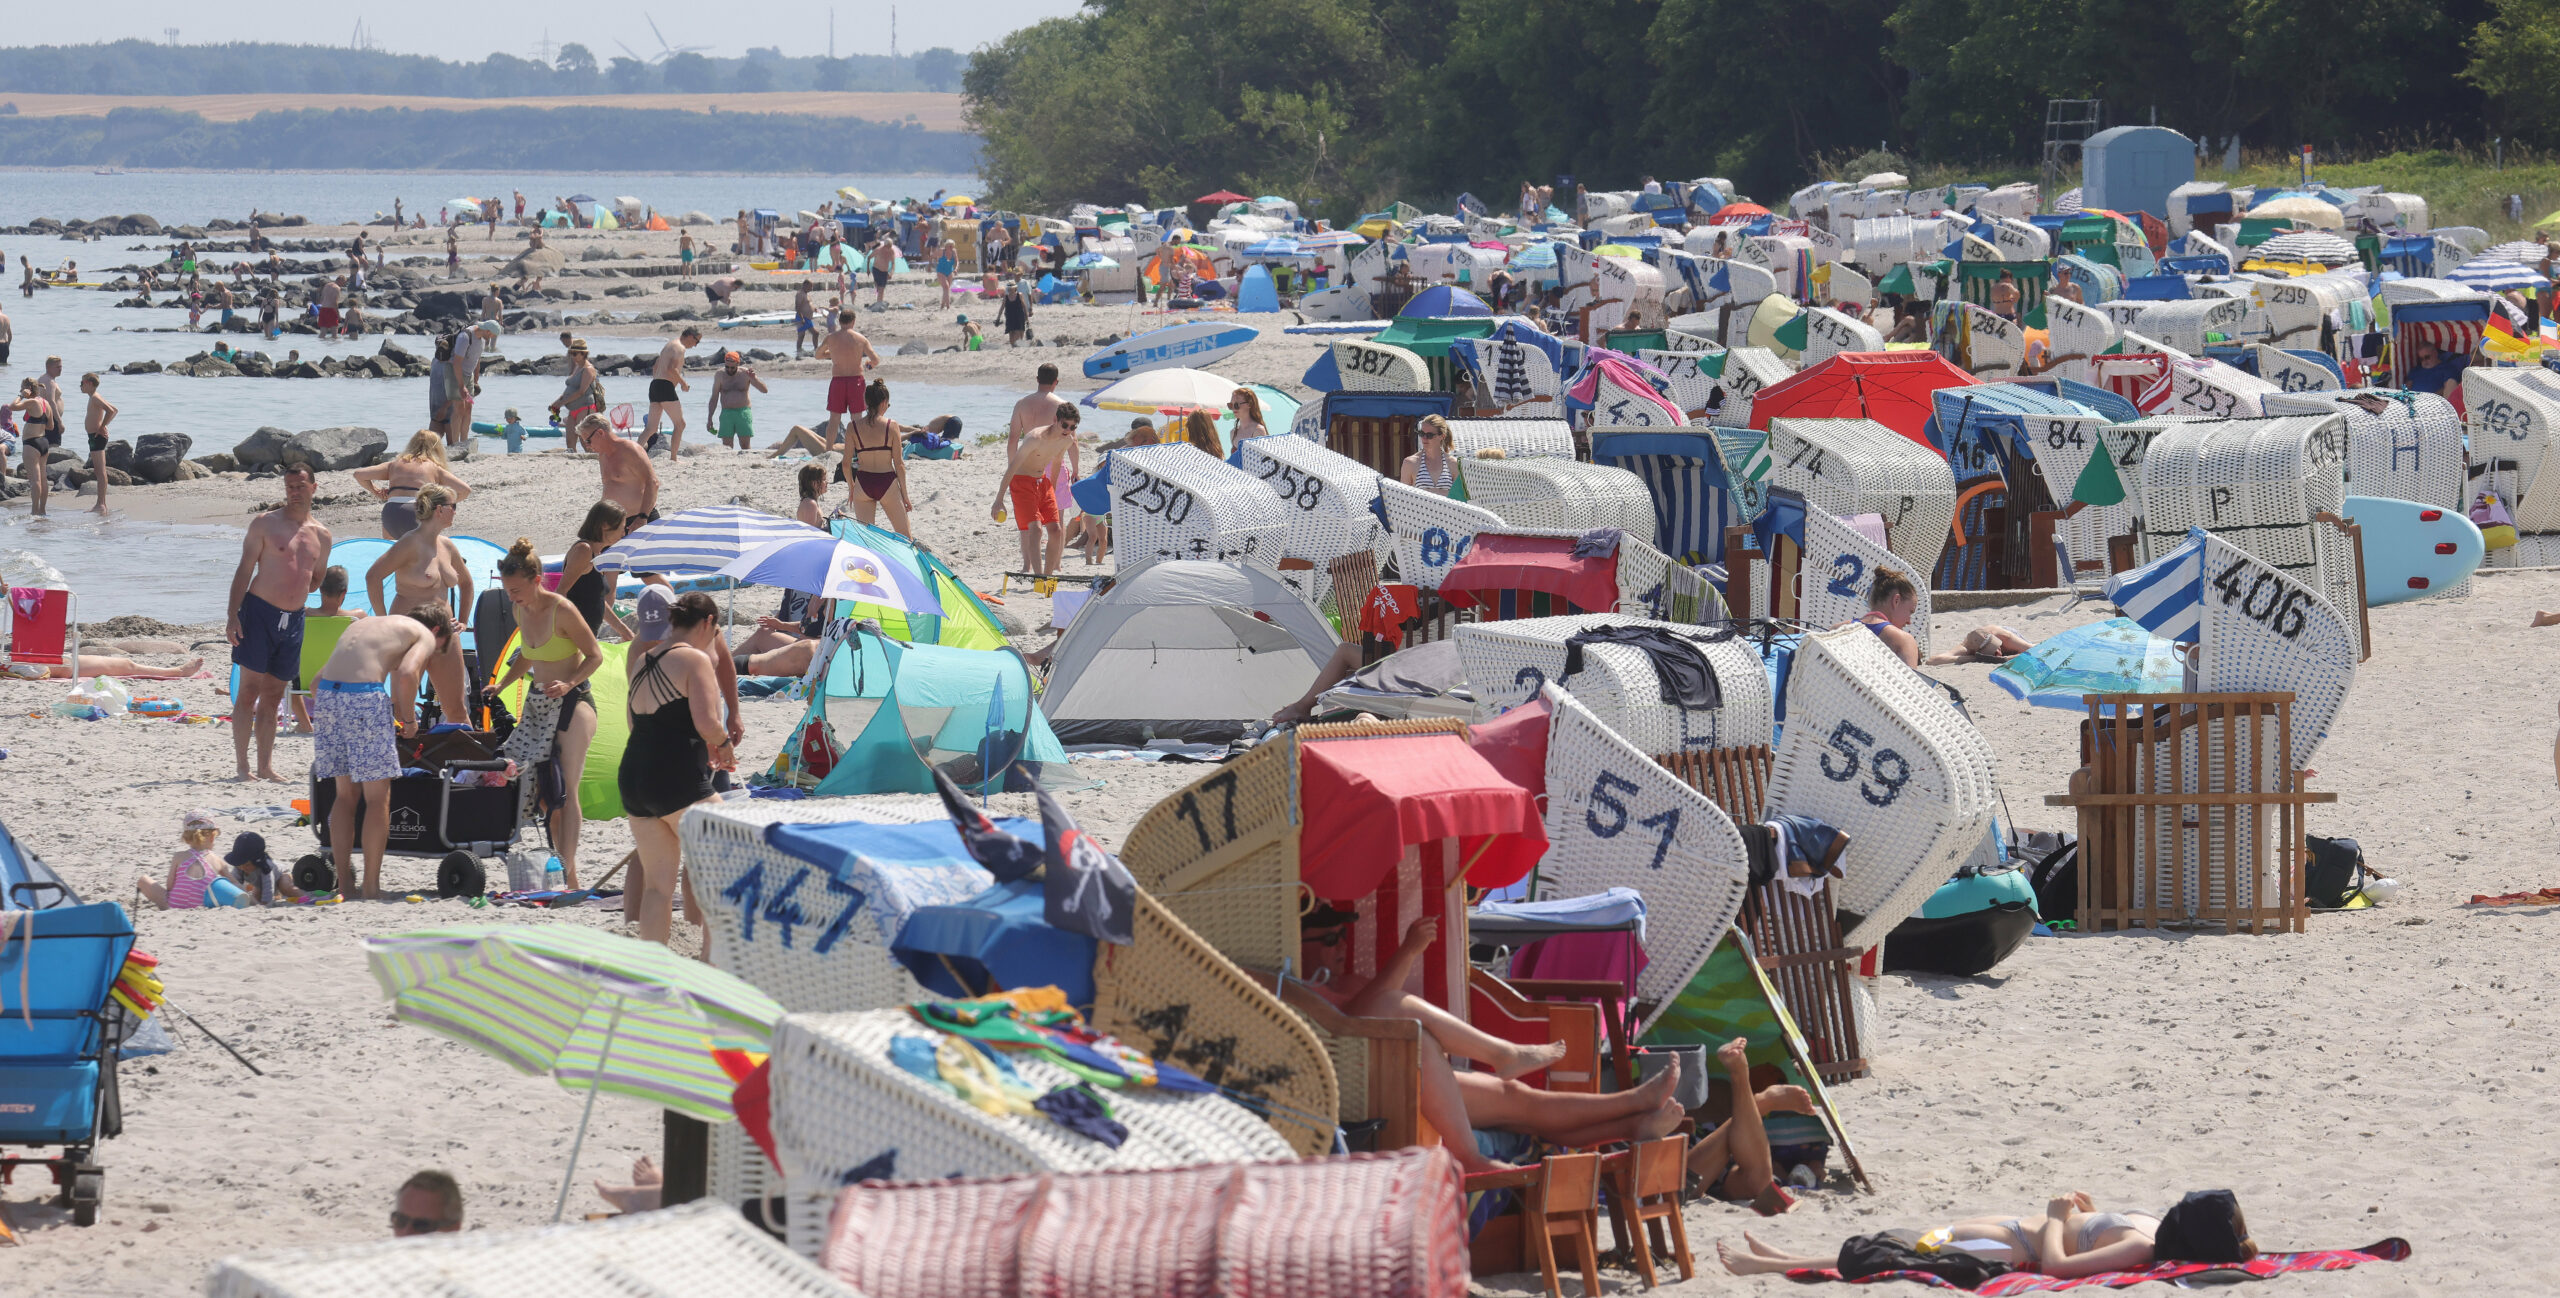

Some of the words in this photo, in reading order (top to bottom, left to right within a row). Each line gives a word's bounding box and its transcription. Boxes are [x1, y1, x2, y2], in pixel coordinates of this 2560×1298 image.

[2000, 231, 2024, 247] 444
[1603, 263, 1627, 283] 244
[2271, 286, 2308, 305] 299
[1812, 315, 1856, 347] 415
[1972, 312, 2008, 340] 284
[1346, 345, 1396, 377] 387
[1653, 355, 1698, 380] 173
[2181, 378, 2237, 418] 253
[2047, 420, 2085, 450] 84
[2477, 399, 2532, 440] 163
[1787, 438, 1824, 479] 74
[1957, 440, 1985, 470] 16
[2392, 428, 2420, 472] H
[1121, 467, 1195, 525] 250
[1260, 456, 1325, 512] 258
[2210, 487, 2231, 521] P
[1896, 495, 1915, 526] P
[1827, 553, 1864, 599] 2
[2213, 557, 2317, 641] 406
[1819, 718, 1912, 809] 59
[1174, 769, 1239, 853] 17
[1586, 769, 1684, 871] 51
[721, 860, 868, 955] 147
